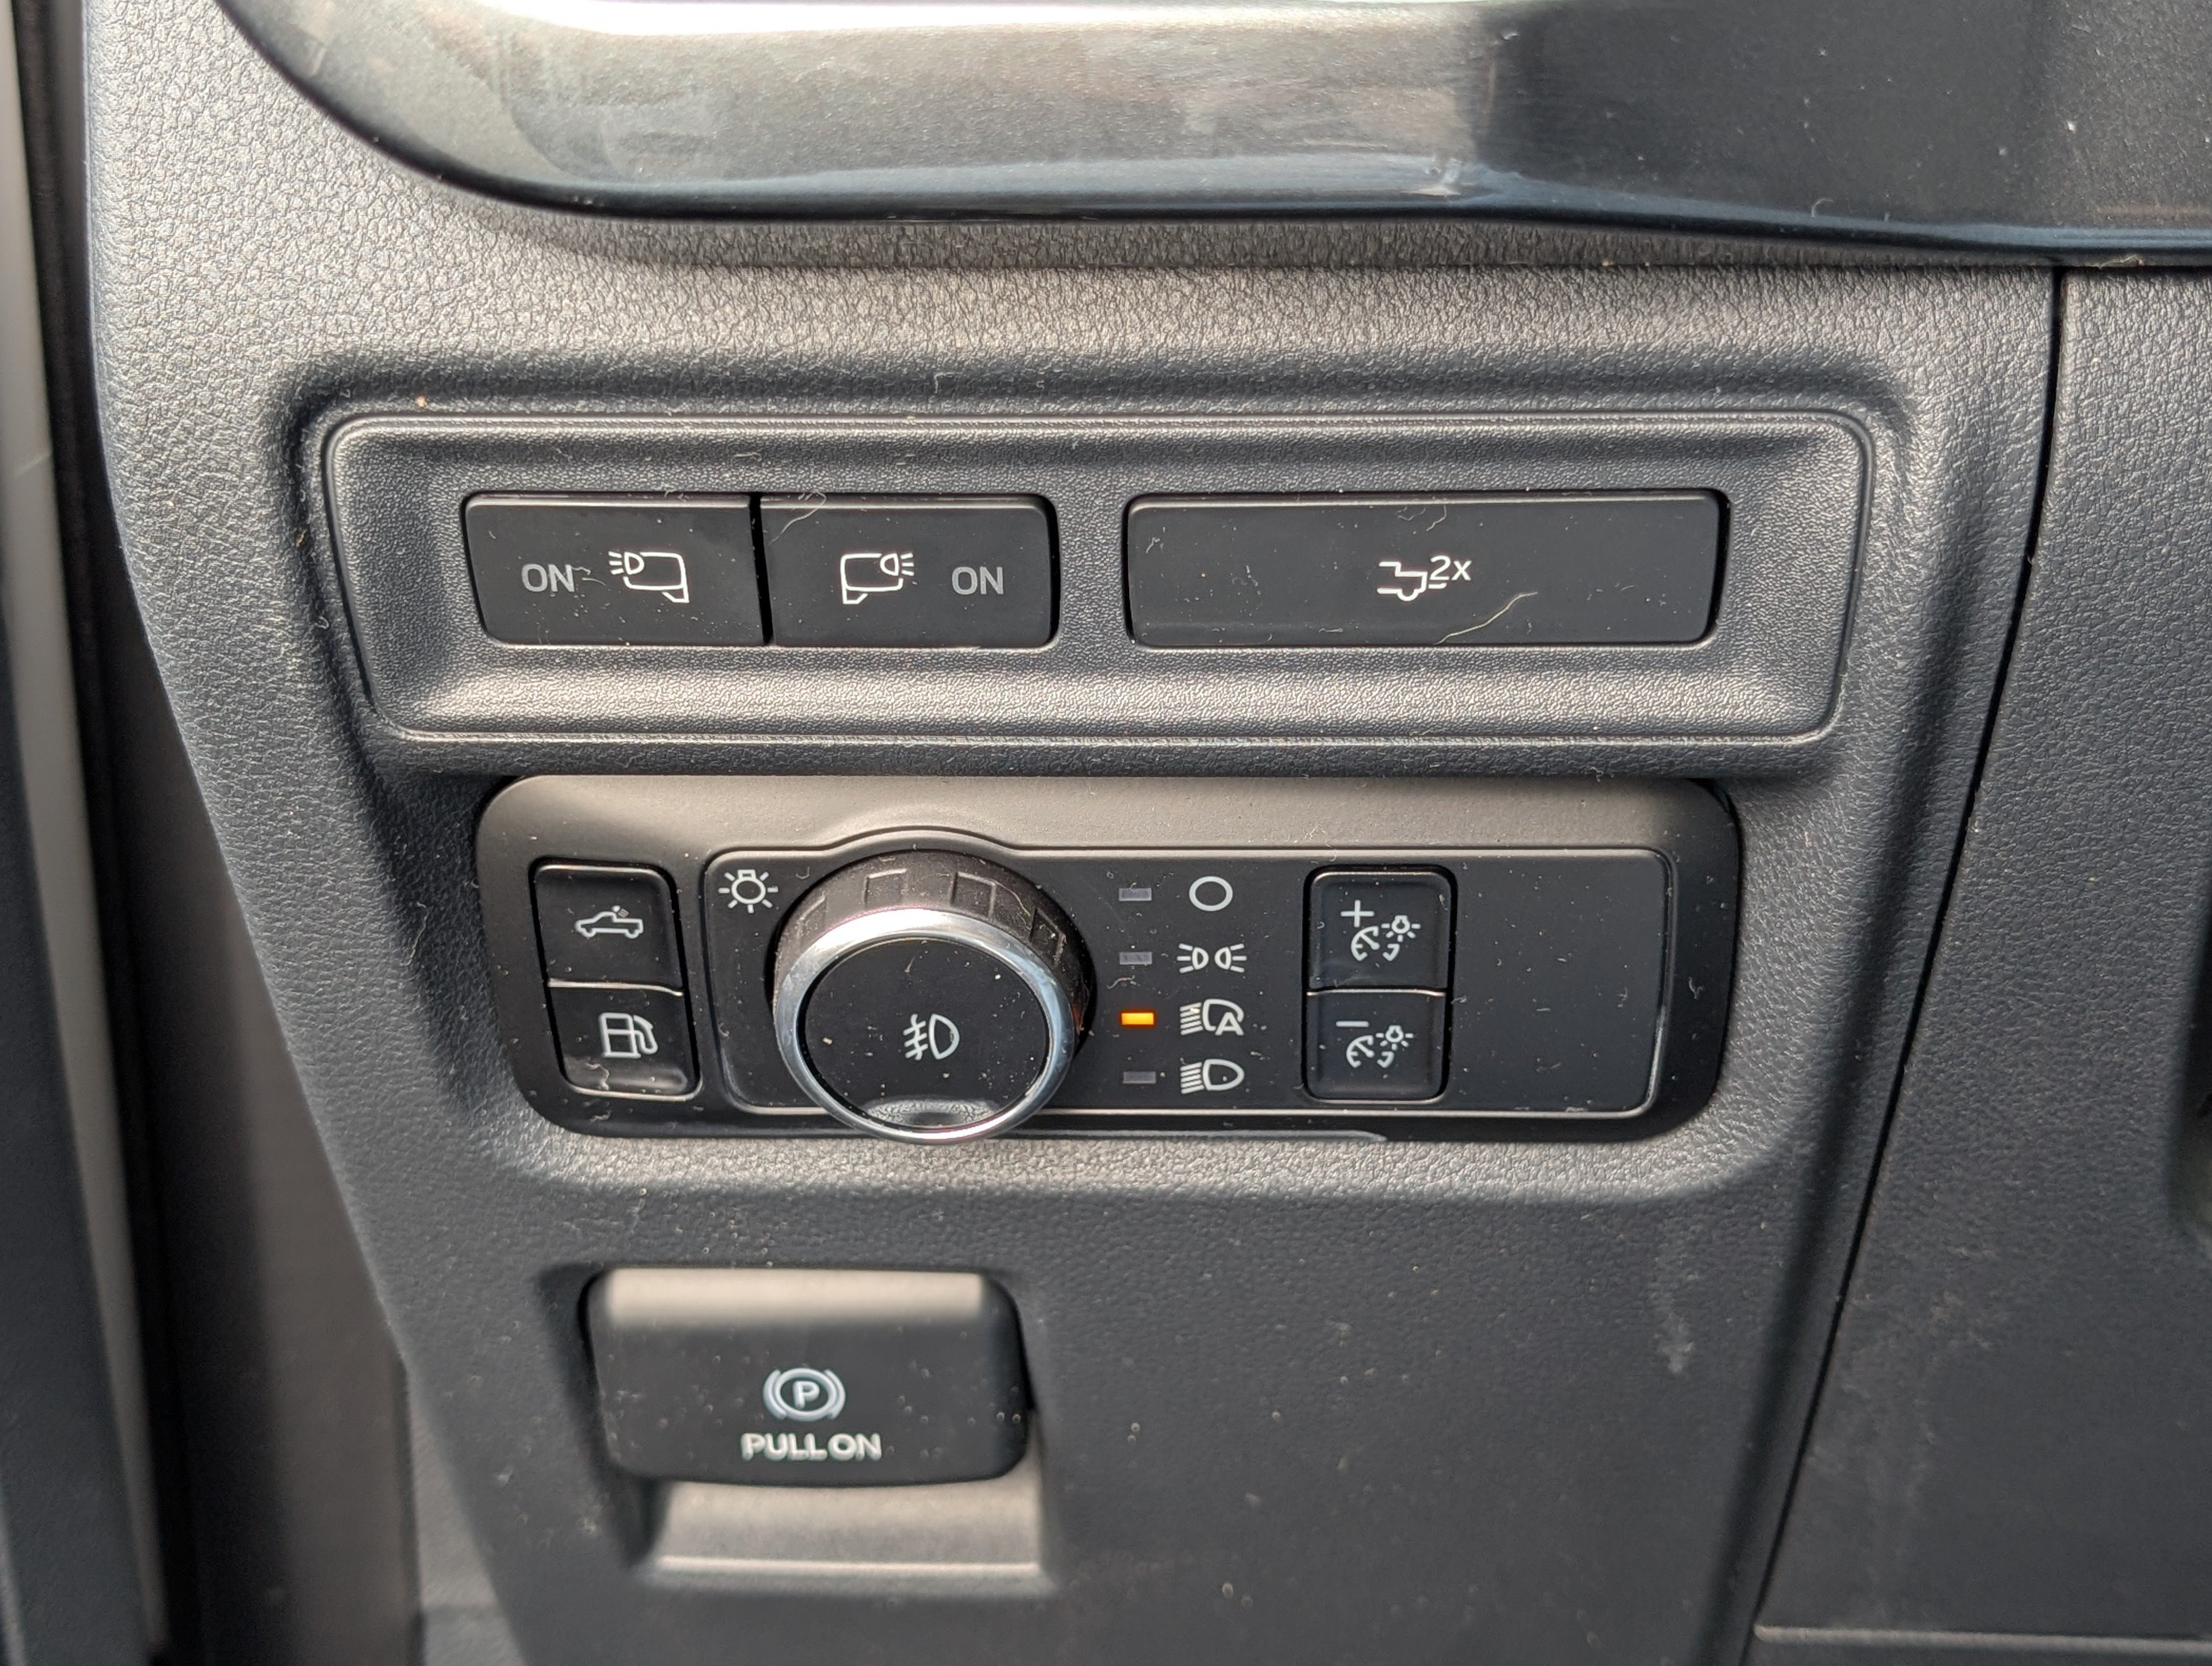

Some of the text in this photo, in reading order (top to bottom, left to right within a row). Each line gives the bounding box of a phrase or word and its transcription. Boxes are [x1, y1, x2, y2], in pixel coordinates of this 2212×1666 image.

[521, 563, 575, 592] ON
[951, 566, 1004, 595] ON
[793, 1380, 820, 1408] P
[741, 1433, 882, 1460] PULL ON
